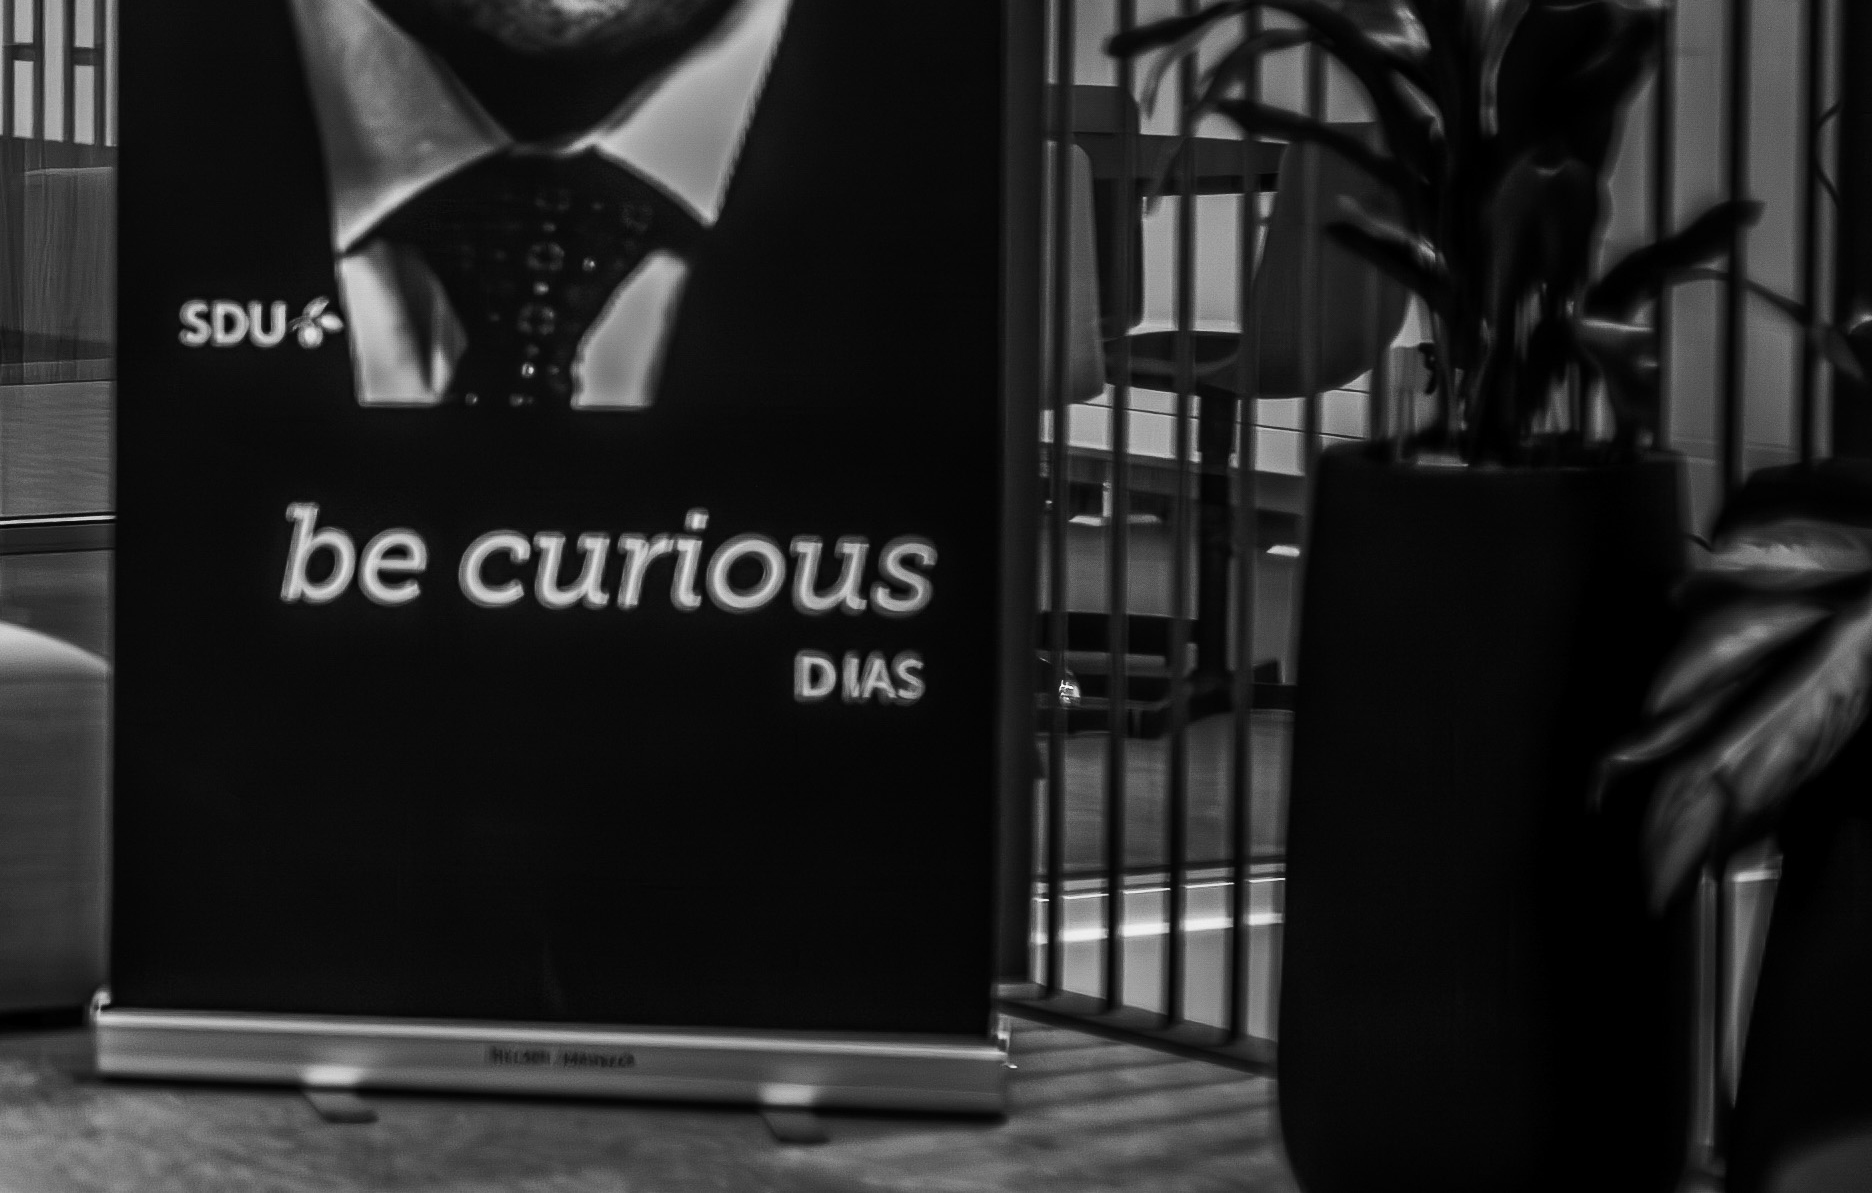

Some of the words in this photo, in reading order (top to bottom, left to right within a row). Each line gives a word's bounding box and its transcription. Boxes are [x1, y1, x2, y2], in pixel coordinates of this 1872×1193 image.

[178, 300, 287, 348] SDU
[280, 502, 427, 607] be
[458, 508, 938, 614] curious
